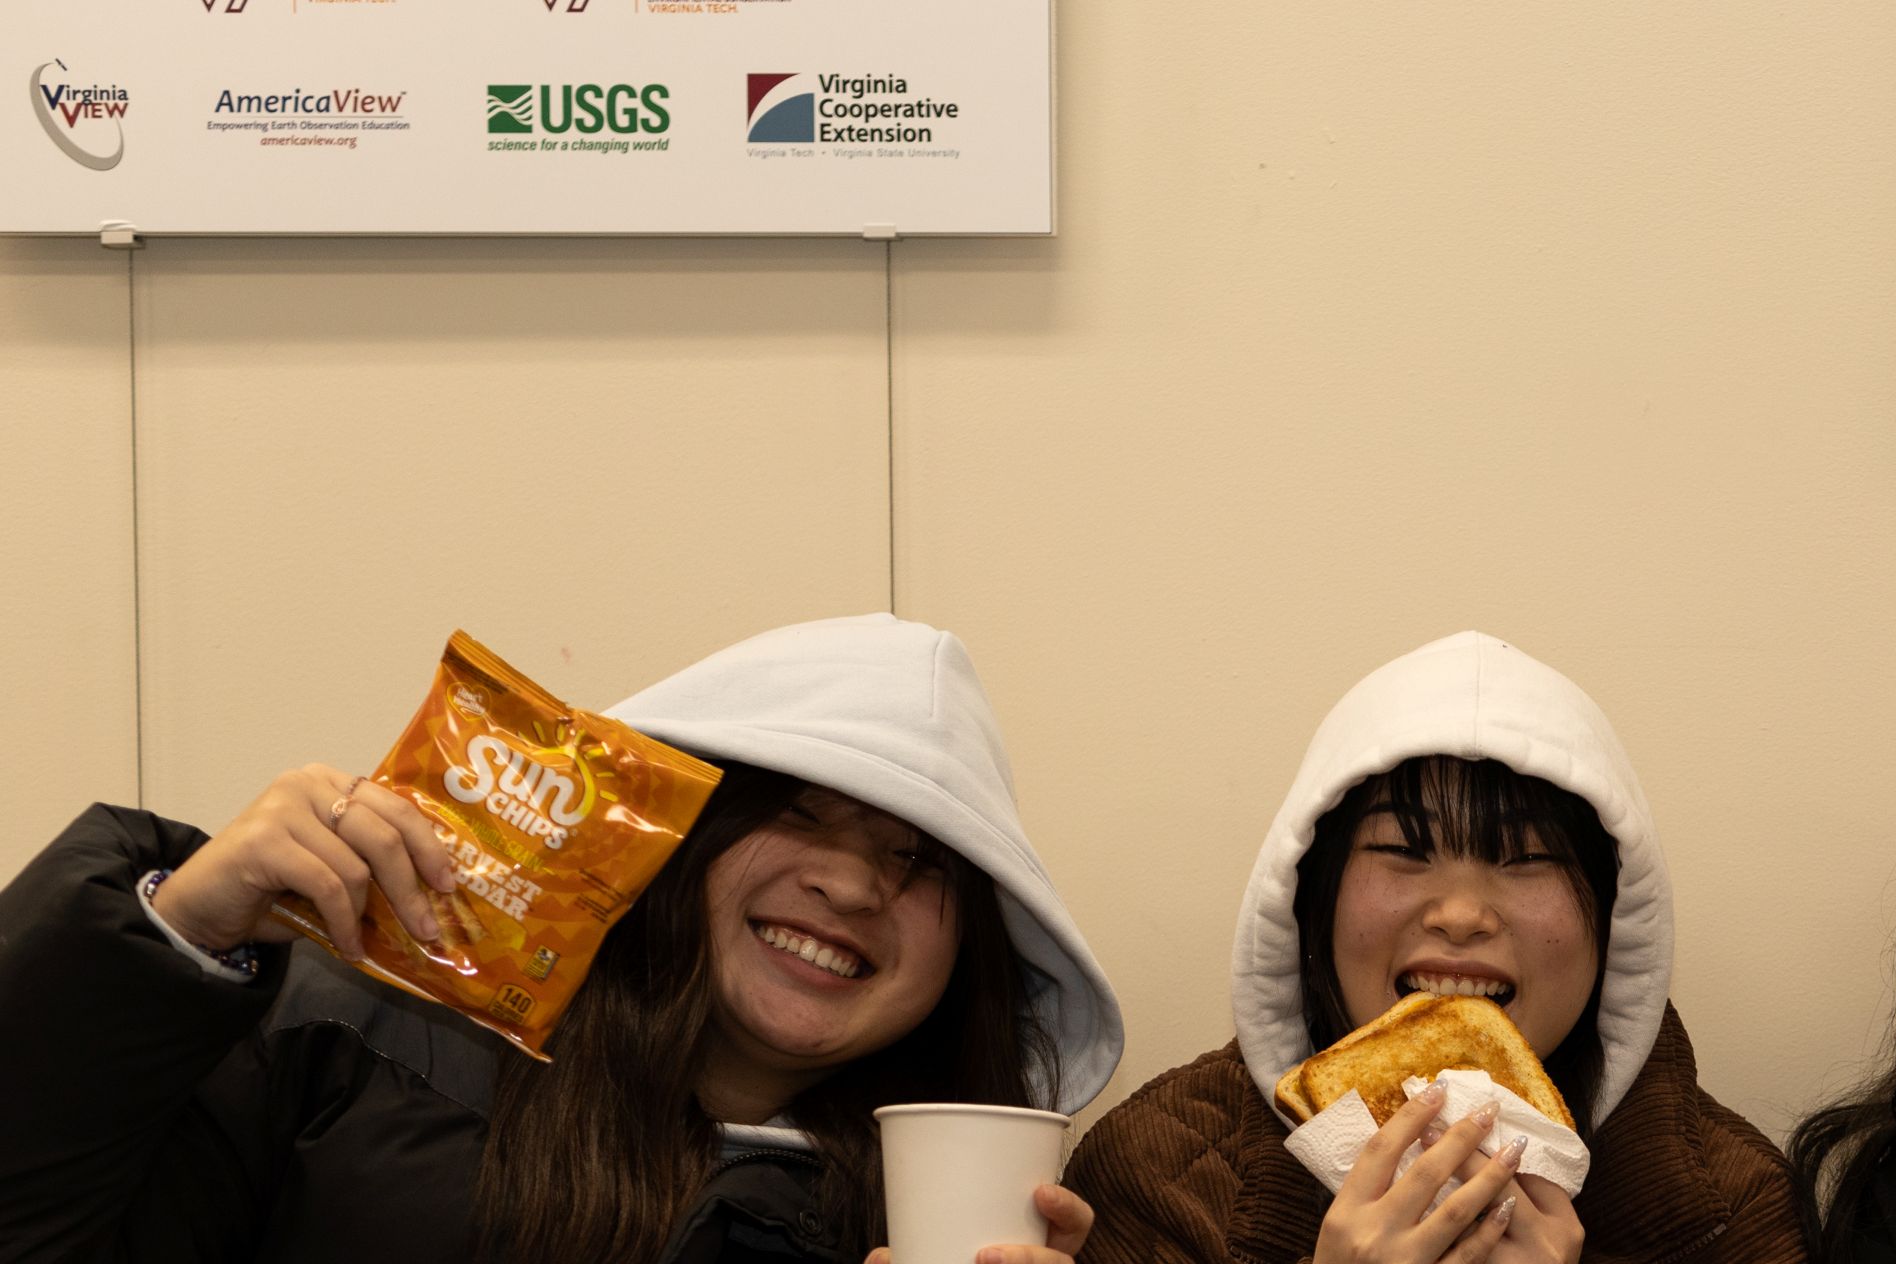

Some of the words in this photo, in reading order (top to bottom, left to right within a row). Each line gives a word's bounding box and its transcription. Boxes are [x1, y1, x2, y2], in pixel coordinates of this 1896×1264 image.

[647, 3, 704, 13] VIRGINIA
[40, 84, 128, 111] Virginia
[818, 74, 907, 99] Virginia
[214, 88, 402, 113] AmericaView
[540, 84, 671, 134] USGS
[818, 98, 959, 123] Cooperative
[58, 102, 129, 129] VIEW
[207, 121, 268, 132] Empowering
[271, 121, 298, 130] Earth
[300, 121, 358, 130] Observation
[361, 121, 410, 130] Education
[260, 135, 357, 149] americaview.org
[819, 122, 932, 143] Extension
[487, 138, 537, 151] science
[540, 138, 557, 151] for
[560, 141, 568, 151] a
[571, 138, 629, 154] changing
[632, 138, 670, 151] world
[444, 734, 595, 826] Sun
[485, 791, 570, 850] CHIPS
[470, 818, 504, 851] WHOLE
[504, 840, 545, 872] GRAIN
[502, 988, 532, 1014] 140
